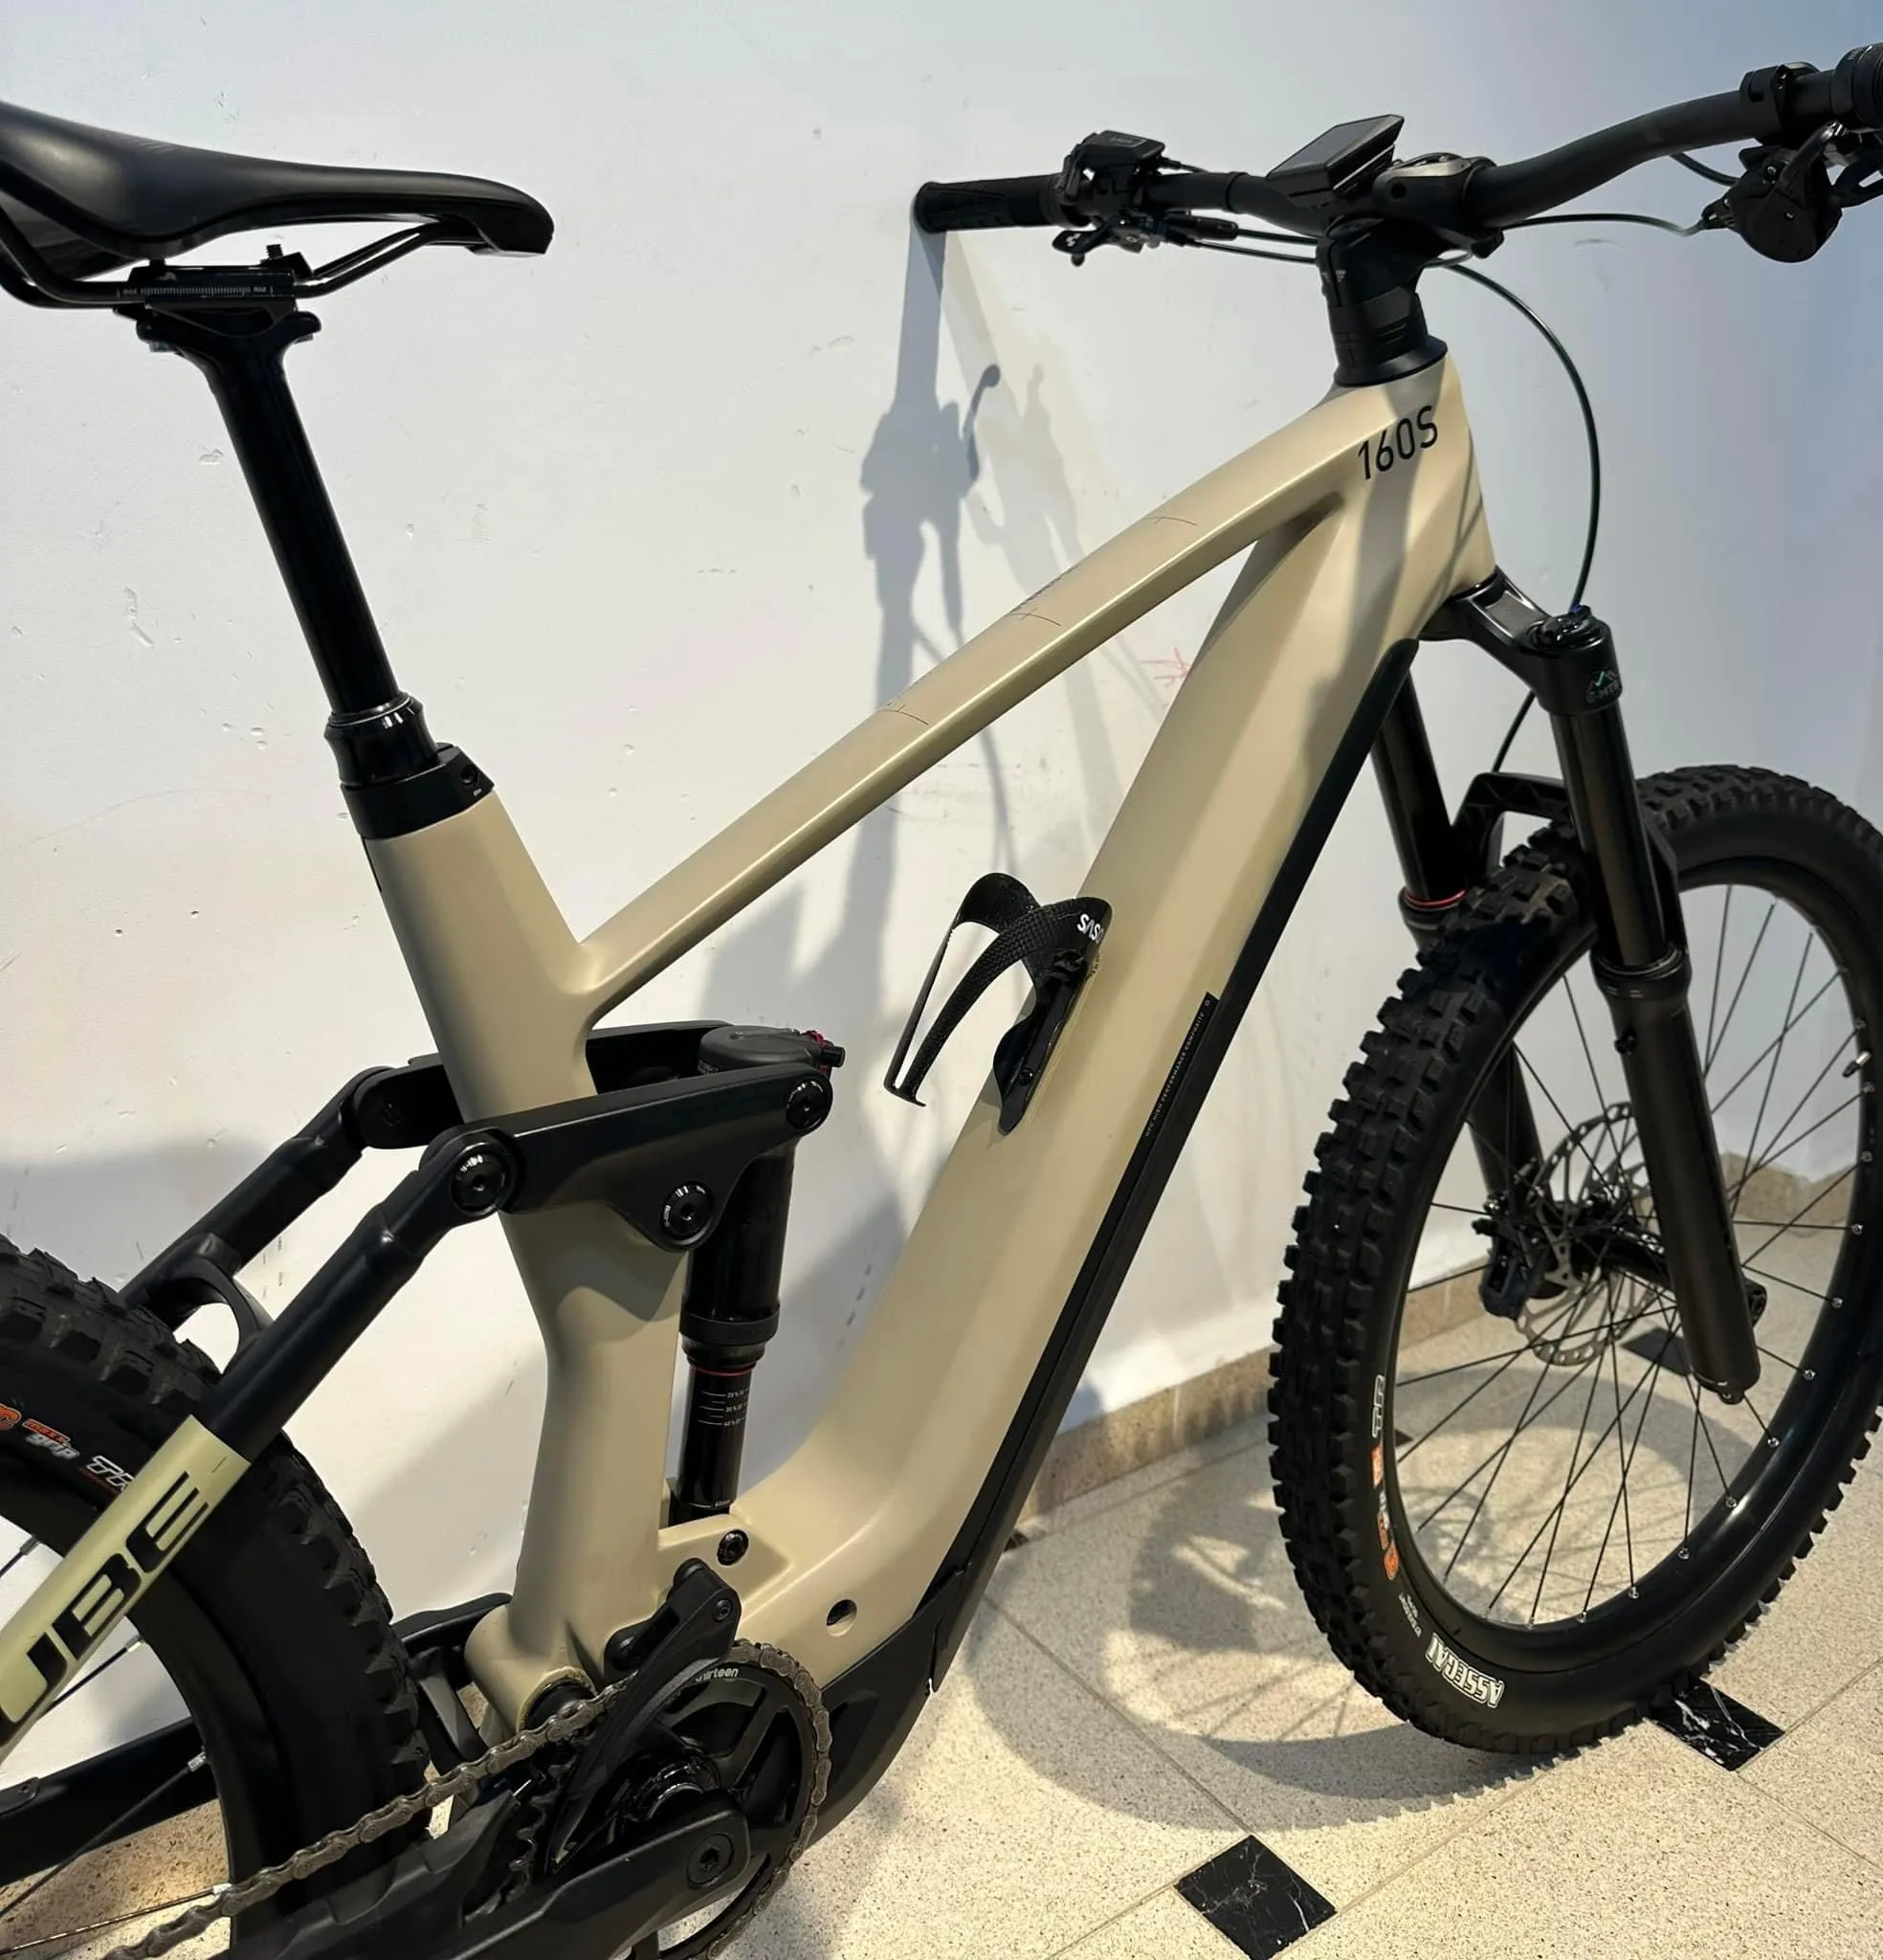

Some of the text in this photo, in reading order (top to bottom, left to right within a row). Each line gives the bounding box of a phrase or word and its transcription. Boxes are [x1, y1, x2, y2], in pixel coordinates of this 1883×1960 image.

[1358, 405, 1438, 480] 160S
[26, 1433, 80, 1459] grip
[1425, 1632, 1505, 1708] ASSEGAI
